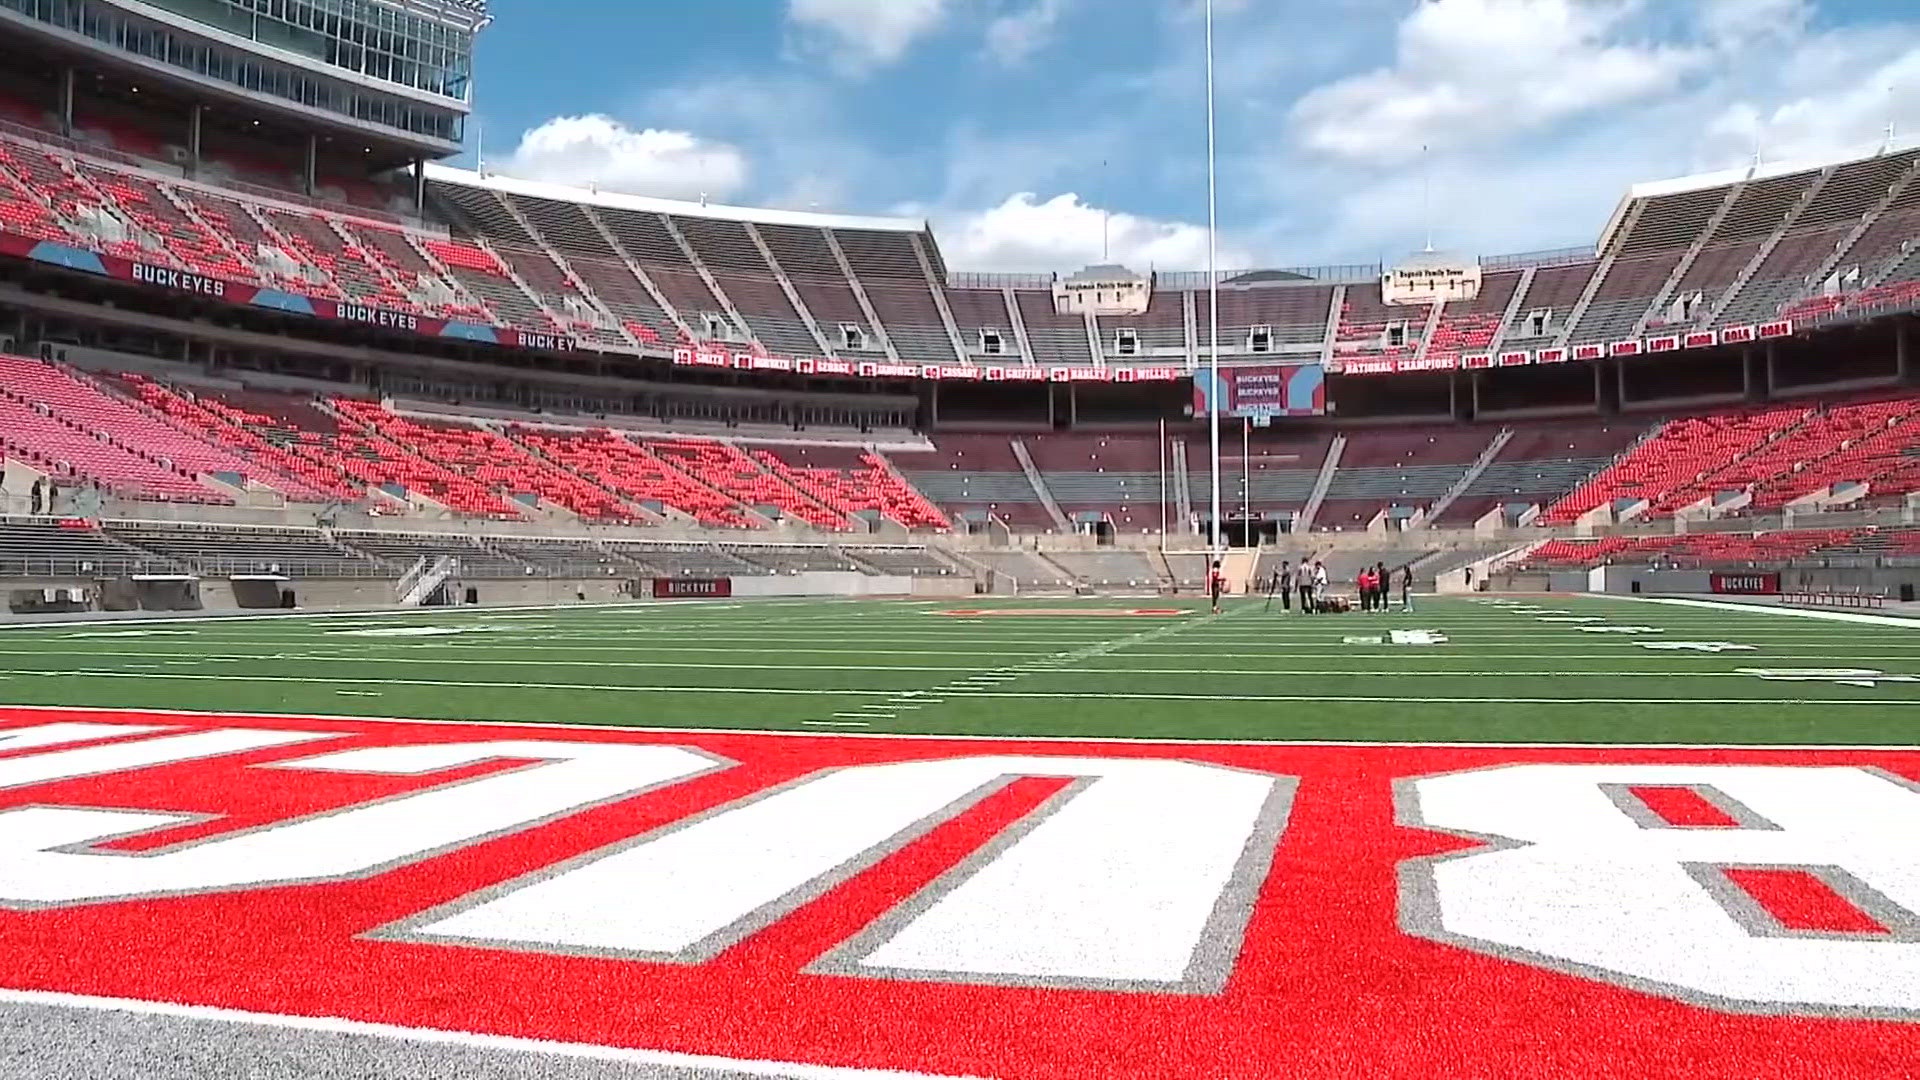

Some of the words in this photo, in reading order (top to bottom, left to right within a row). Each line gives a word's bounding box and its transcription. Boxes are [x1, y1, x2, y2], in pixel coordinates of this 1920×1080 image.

[132, 262, 224, 296] BUCKEYES
[336, 303, 418, 330] BUCKEYES
[1136, 368, 1171, 380] WILLIS
[1345, 362, 1392, 375] NATIONAL
[1398, 359, 1454, 371] CHAMPIONS
[668, 582, 716, 593] BUCKEYES
[1721, 577, 1764, 589] BUCKEYES
